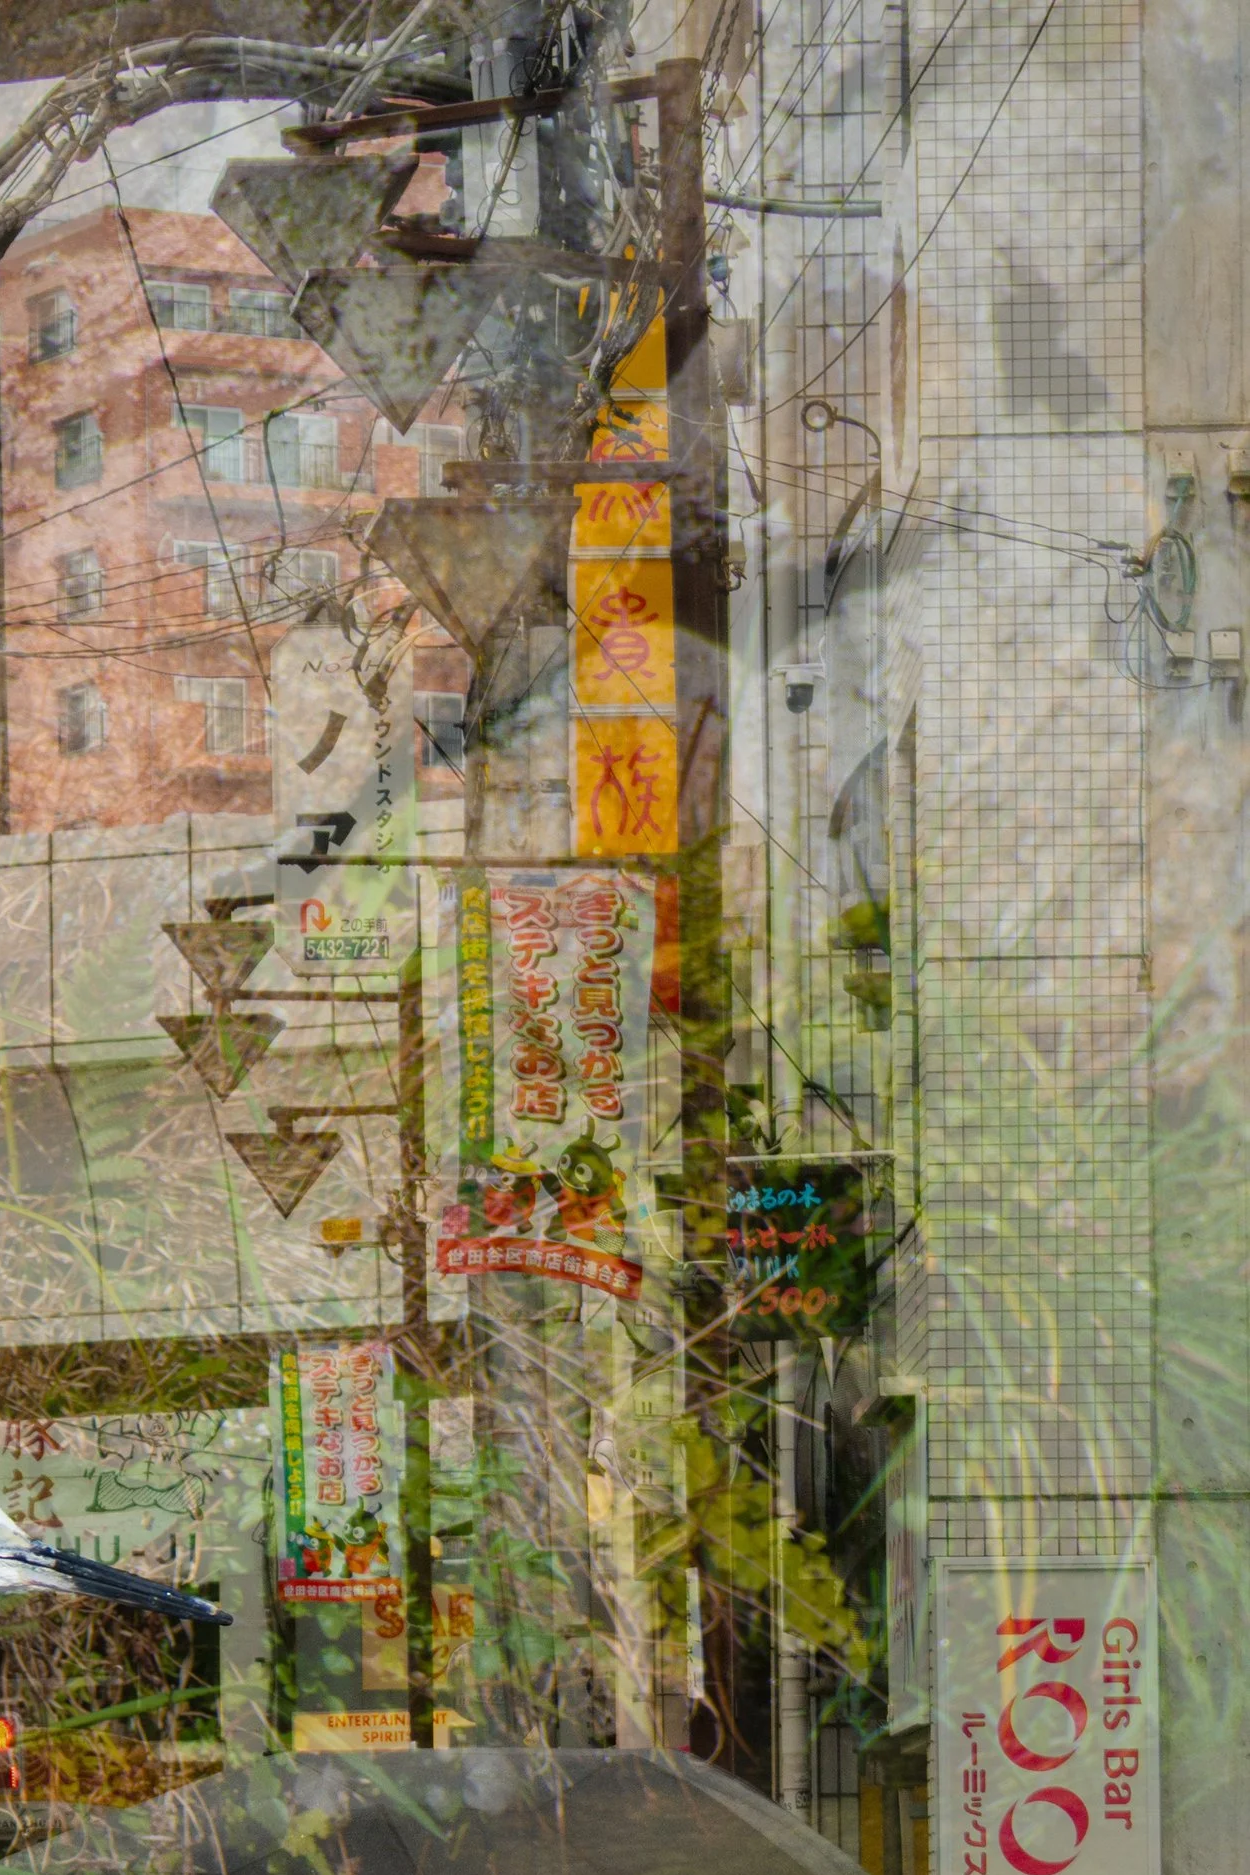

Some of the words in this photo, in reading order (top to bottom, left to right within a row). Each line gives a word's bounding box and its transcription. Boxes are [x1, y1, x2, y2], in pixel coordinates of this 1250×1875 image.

[305, 936, 389, 959] 5432-7221
[340, 917, 388, 933] この手前
[507, 892, 564, 1118] ステキなお店
[574, 892, 620, 1114] きっと見つかる
[310, 1354, 345, 1505] ステキなお店
[351, 1352, 382, 1494] きっと見つかる
[327, 1711, 448, 1729] ENTERTAINNT
[1102, 1617, 1142, 1731] Girls
[1103, 1748, 1139, 1830] Bar
